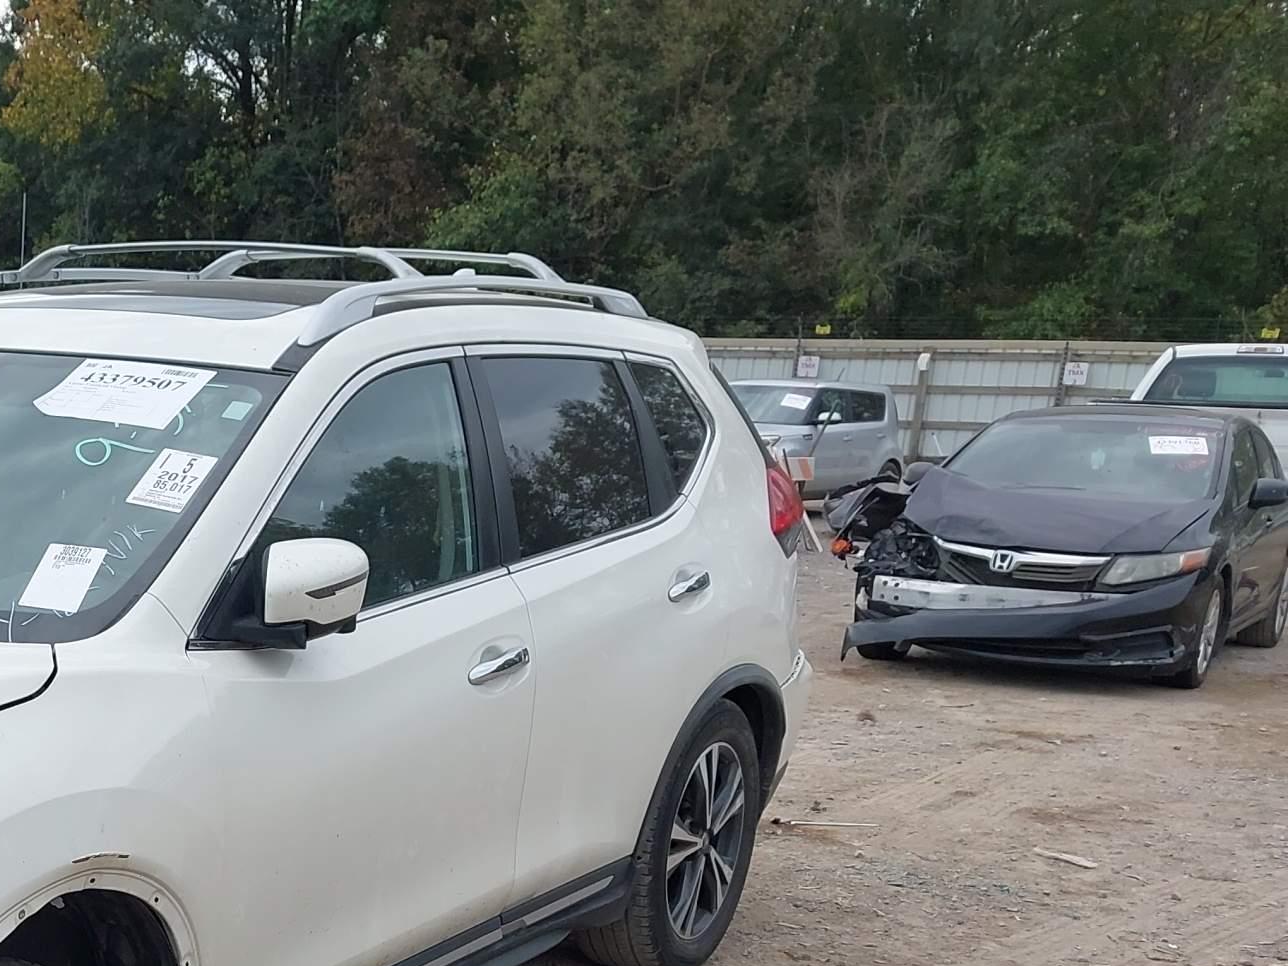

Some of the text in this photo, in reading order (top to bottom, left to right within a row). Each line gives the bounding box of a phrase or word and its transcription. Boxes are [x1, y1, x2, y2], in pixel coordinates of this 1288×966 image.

[80, 371, 188, 391] 43379507
[182, 458, 198, 474] 5
[157, 470, 199, 485] 2017
